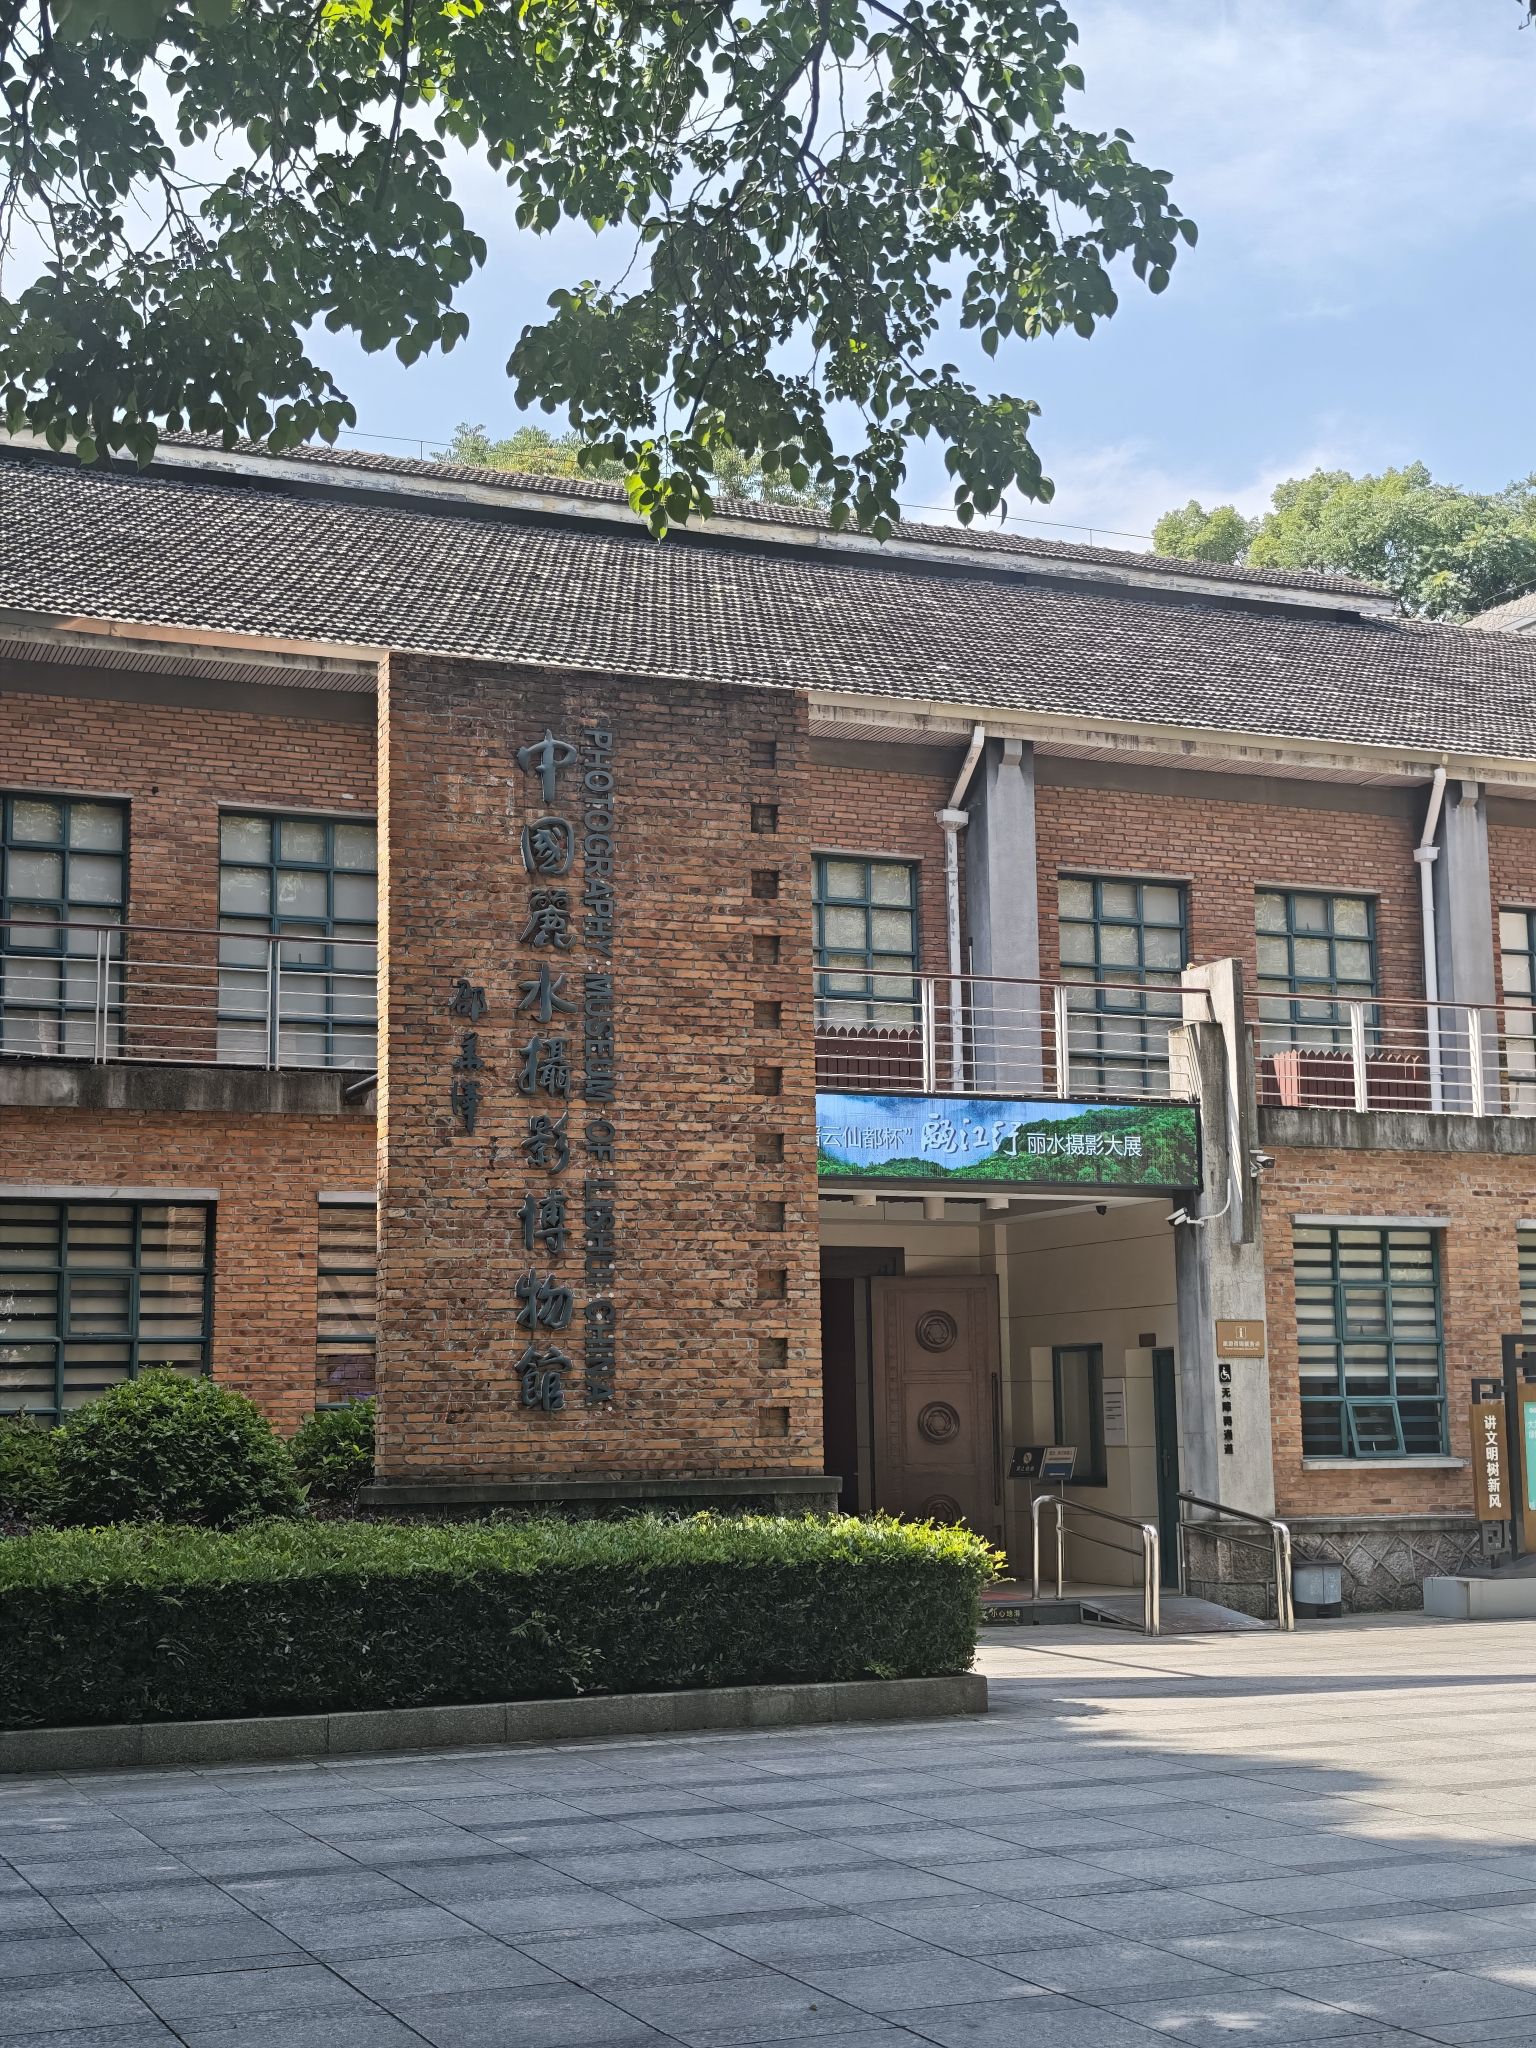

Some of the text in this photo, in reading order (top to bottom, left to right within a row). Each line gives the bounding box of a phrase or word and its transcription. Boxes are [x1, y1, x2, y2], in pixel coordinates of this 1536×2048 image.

[584, 727, 616, 1405] PHOTOGRAPHY MUSEUM OF LISHUI CHINA
[1027, 1131, 1143, 1158] 丽水摄影大展
[1221, 1387, 1234, 1455] 无障碍通道
[1483, 1415, 1502, 1508] 讲文明树新风
